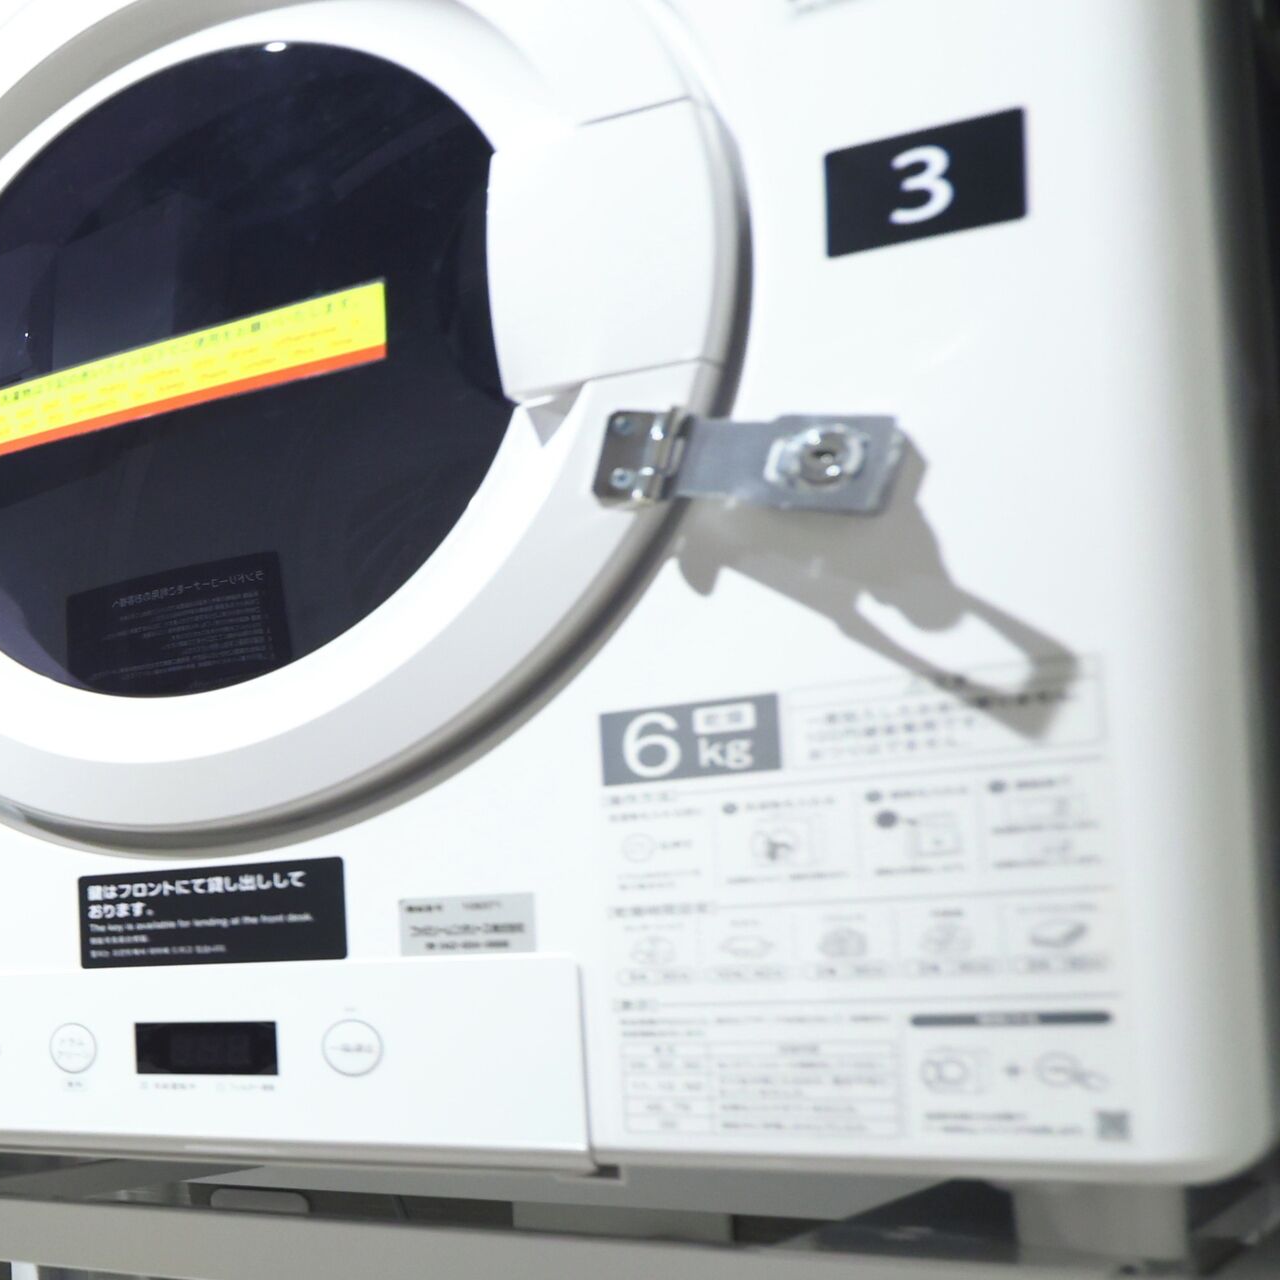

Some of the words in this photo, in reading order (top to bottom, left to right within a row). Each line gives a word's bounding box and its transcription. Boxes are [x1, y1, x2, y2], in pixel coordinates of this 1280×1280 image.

[889, 144, 955, 225] 3
[621, 710, 682, 777] 6
[696, 735, 754, 769] kg
[86, 870, 307, 902] 鍵はフロントにて貸し出しして
[87, 901, 155, 919] おります。
[89, 922, 106, 933] The
[136, 919, 176, 931] available
